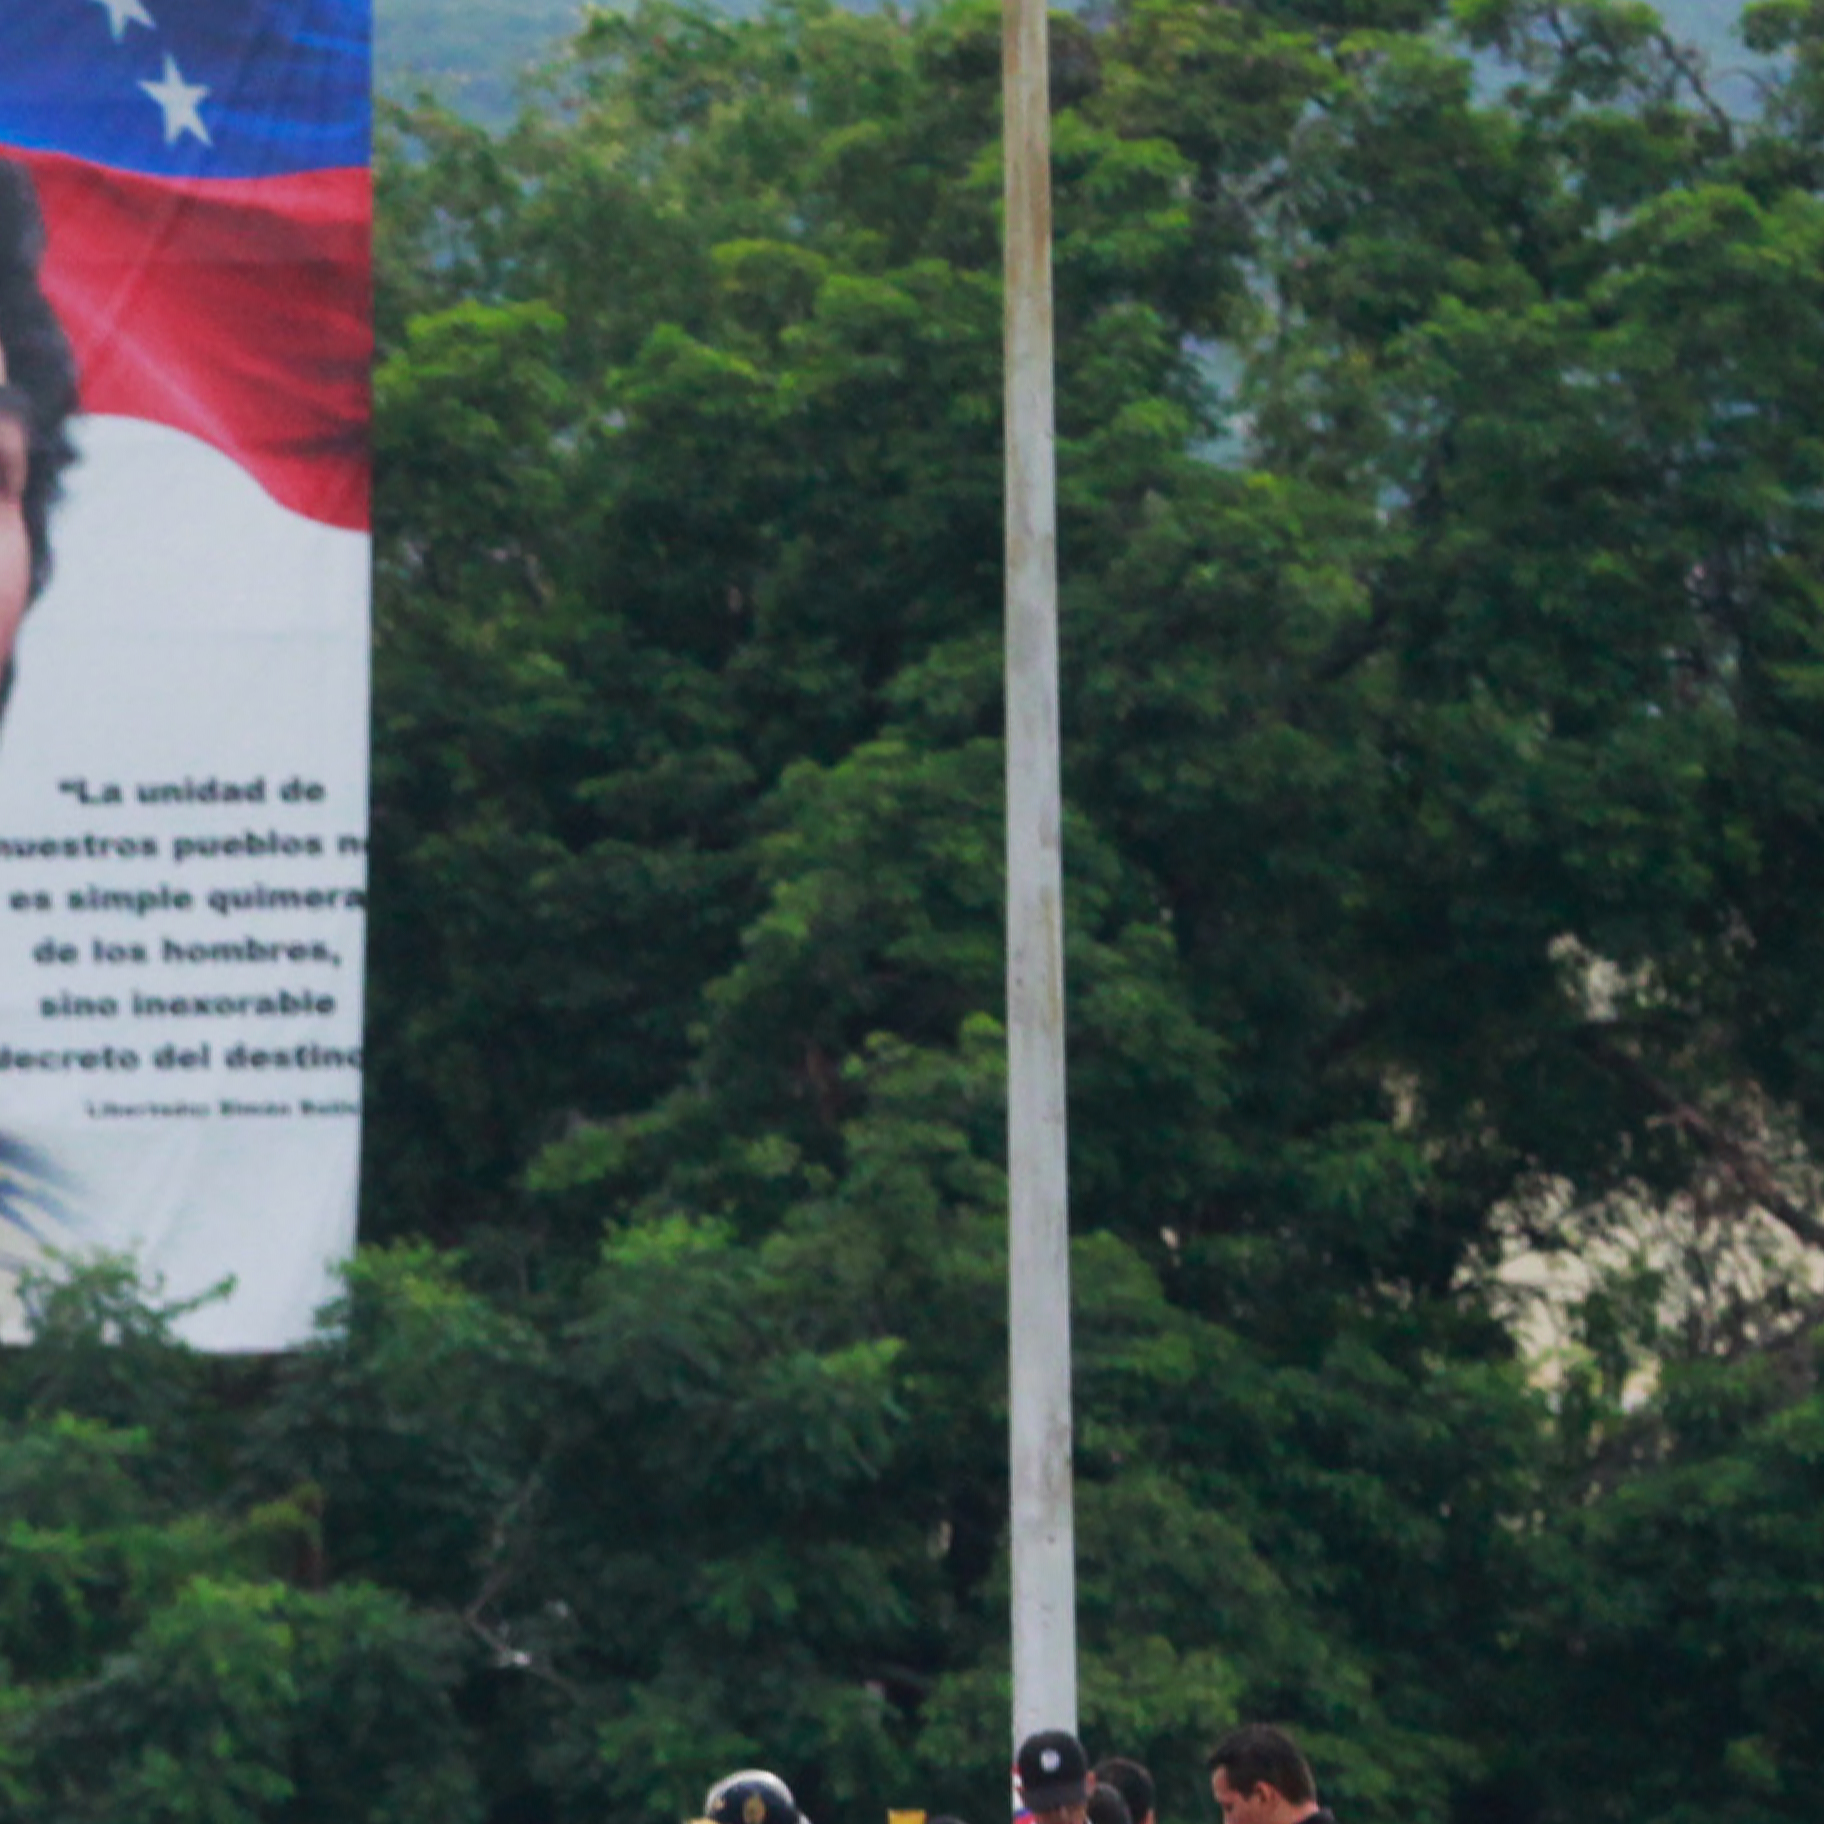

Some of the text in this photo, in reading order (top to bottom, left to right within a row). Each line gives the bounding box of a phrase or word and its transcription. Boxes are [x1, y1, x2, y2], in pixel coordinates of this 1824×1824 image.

[136, 776, 266, 802] unidad
[279, 776, 325, 802] de
[173, 830, 323, 863] pueblos
[9, 884, 369, 915] es simple quimera
[33, 937, 343, 968] de los hombres,
[40, 989, 336, 1018] sino inexorable
[153, 1042, 211, 1071] del
